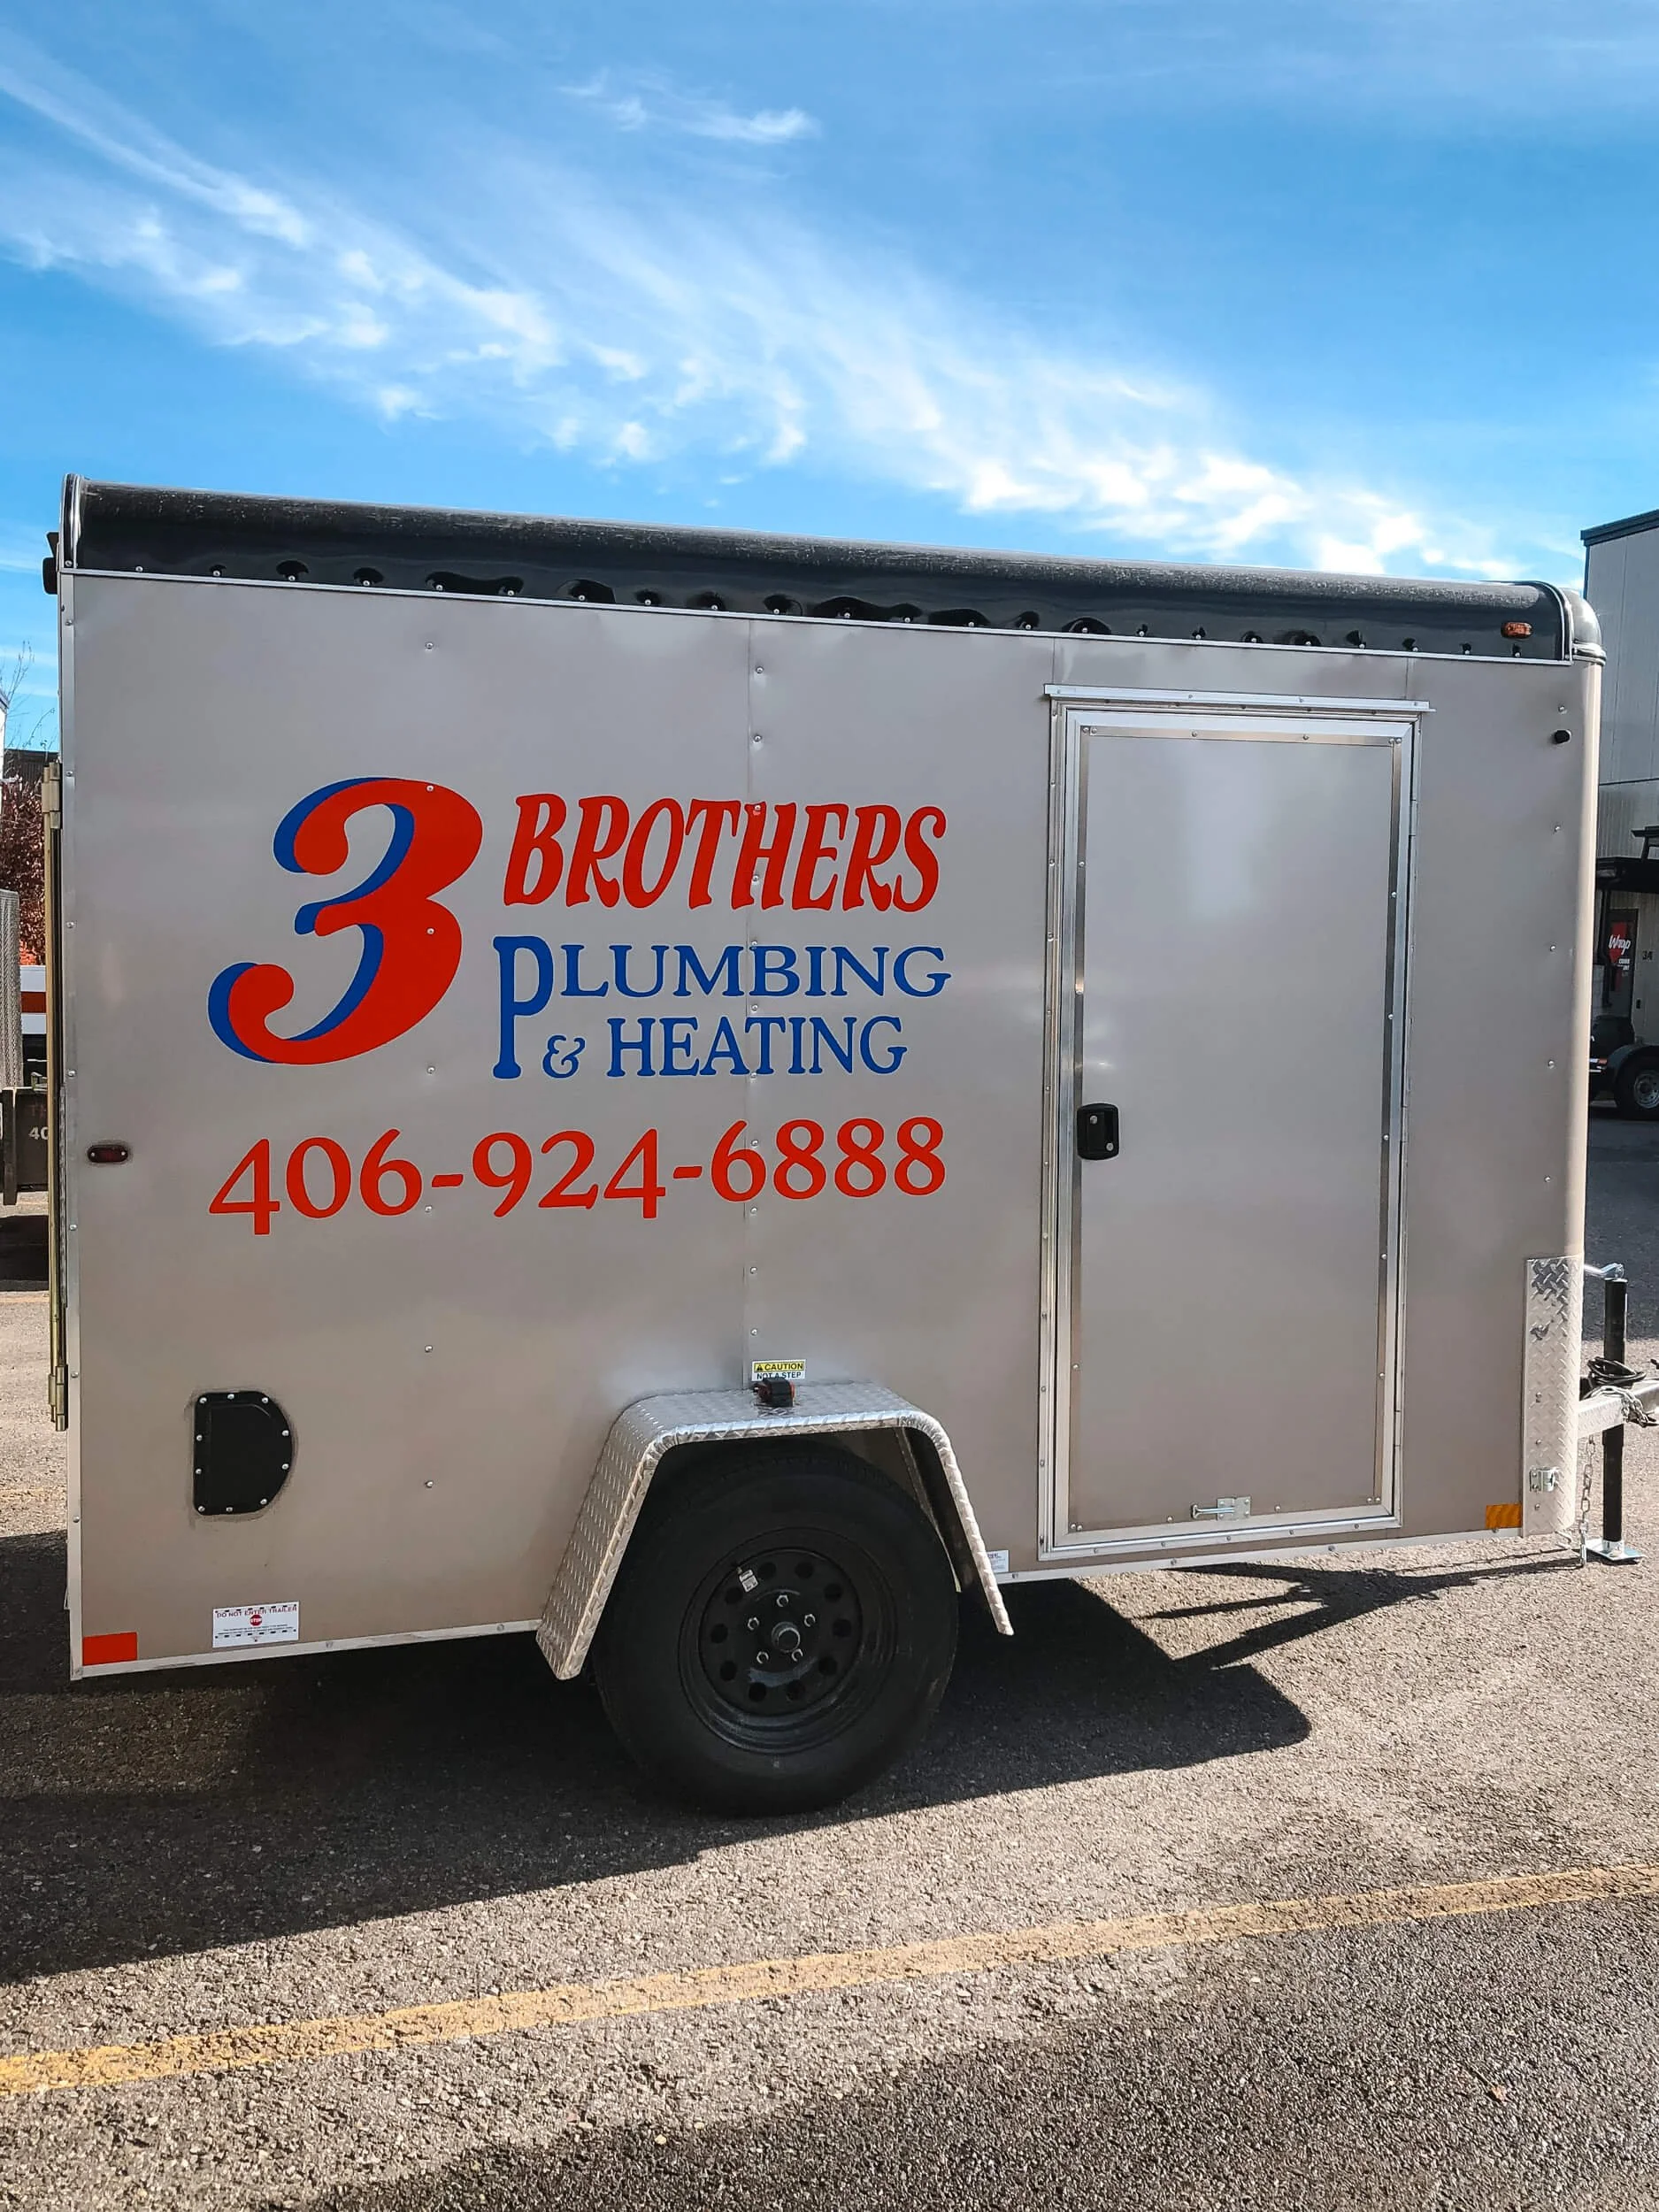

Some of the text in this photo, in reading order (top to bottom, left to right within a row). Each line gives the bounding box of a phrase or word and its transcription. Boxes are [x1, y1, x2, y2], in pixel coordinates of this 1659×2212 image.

[208, 777, 947, 1065] 3 BROTHERS
[492, 934, 952, 1079] PLUMBING
[541, 1016, 908, 1079] & HEATING
[208, 1117, 947, 1235] 406-924-6888
